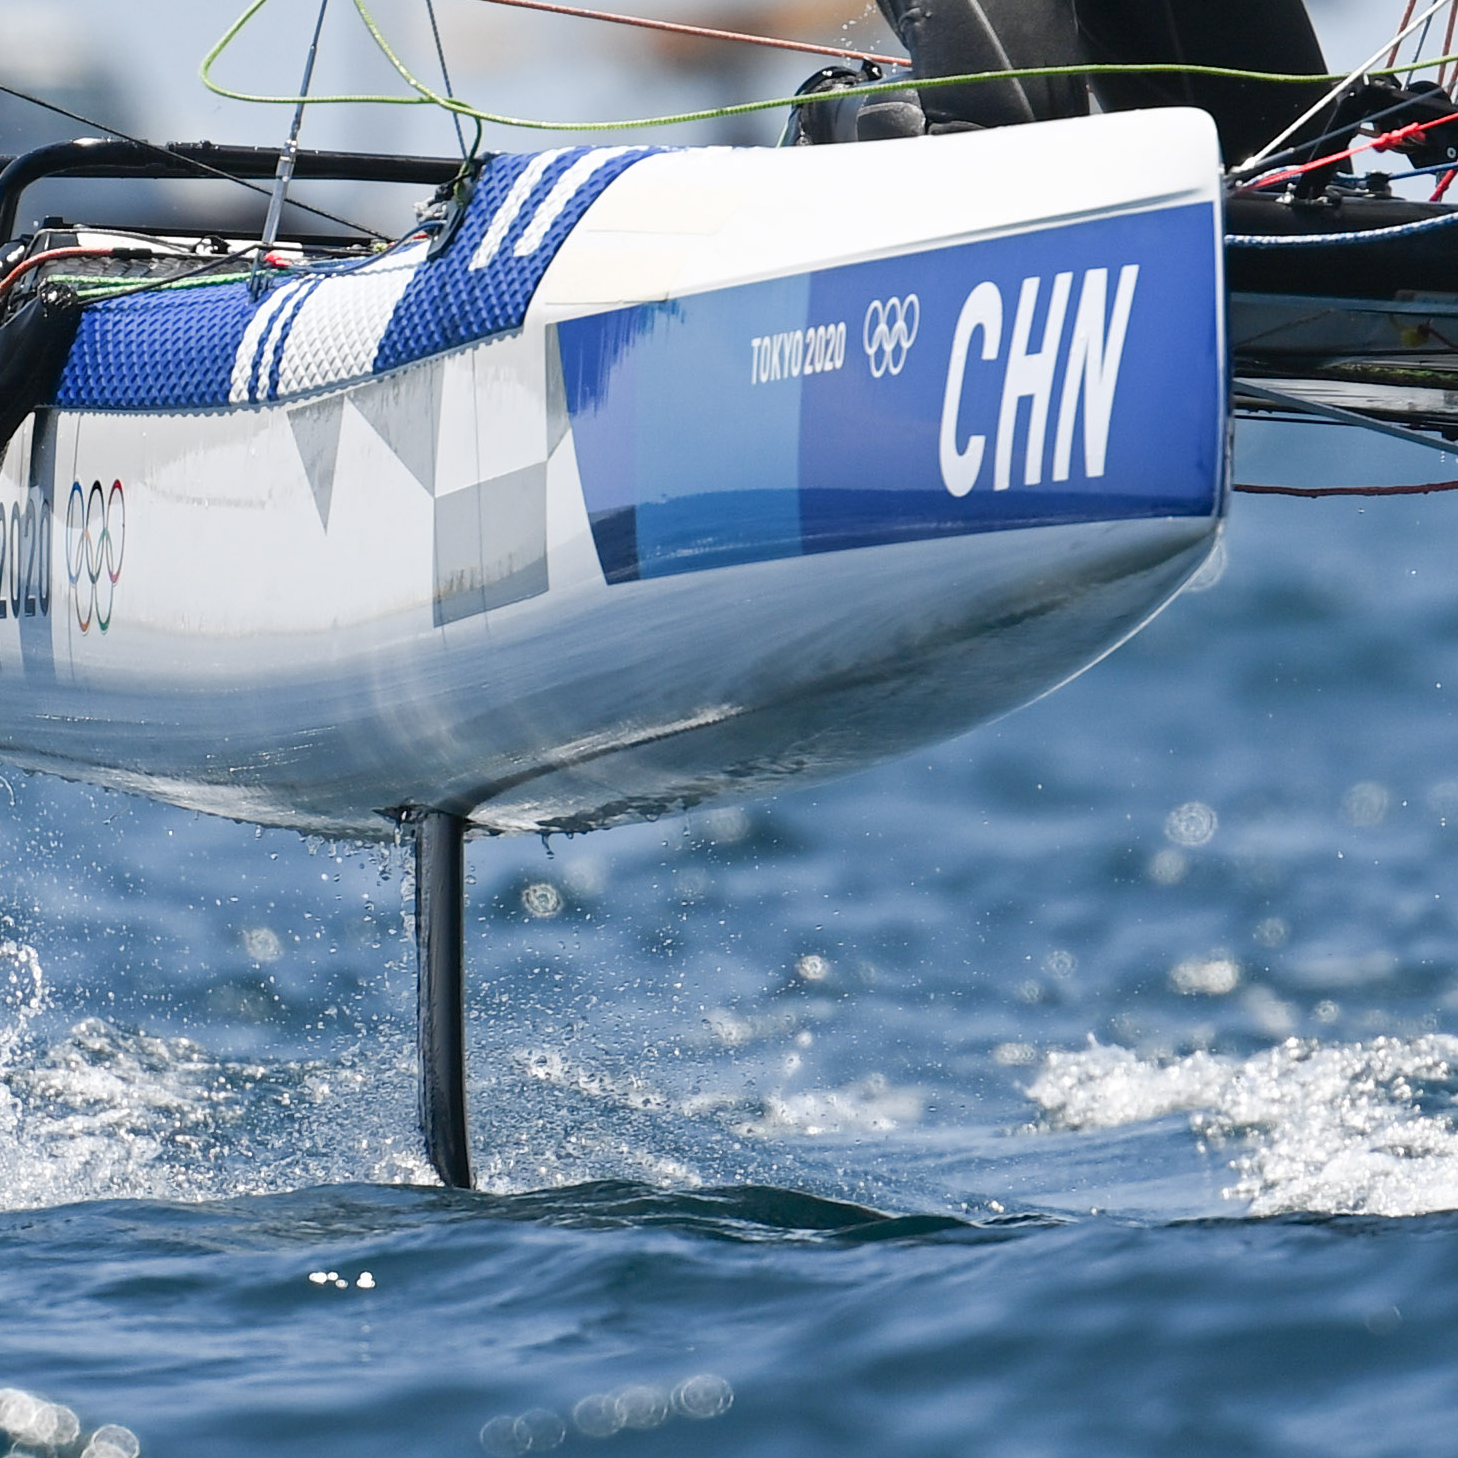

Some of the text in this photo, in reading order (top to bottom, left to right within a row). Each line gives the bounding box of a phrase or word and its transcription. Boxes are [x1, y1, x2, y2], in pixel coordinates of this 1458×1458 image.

[751, 321, 847, 385] TOKYO 2020
[939, 264, 1140, 497] CHN
